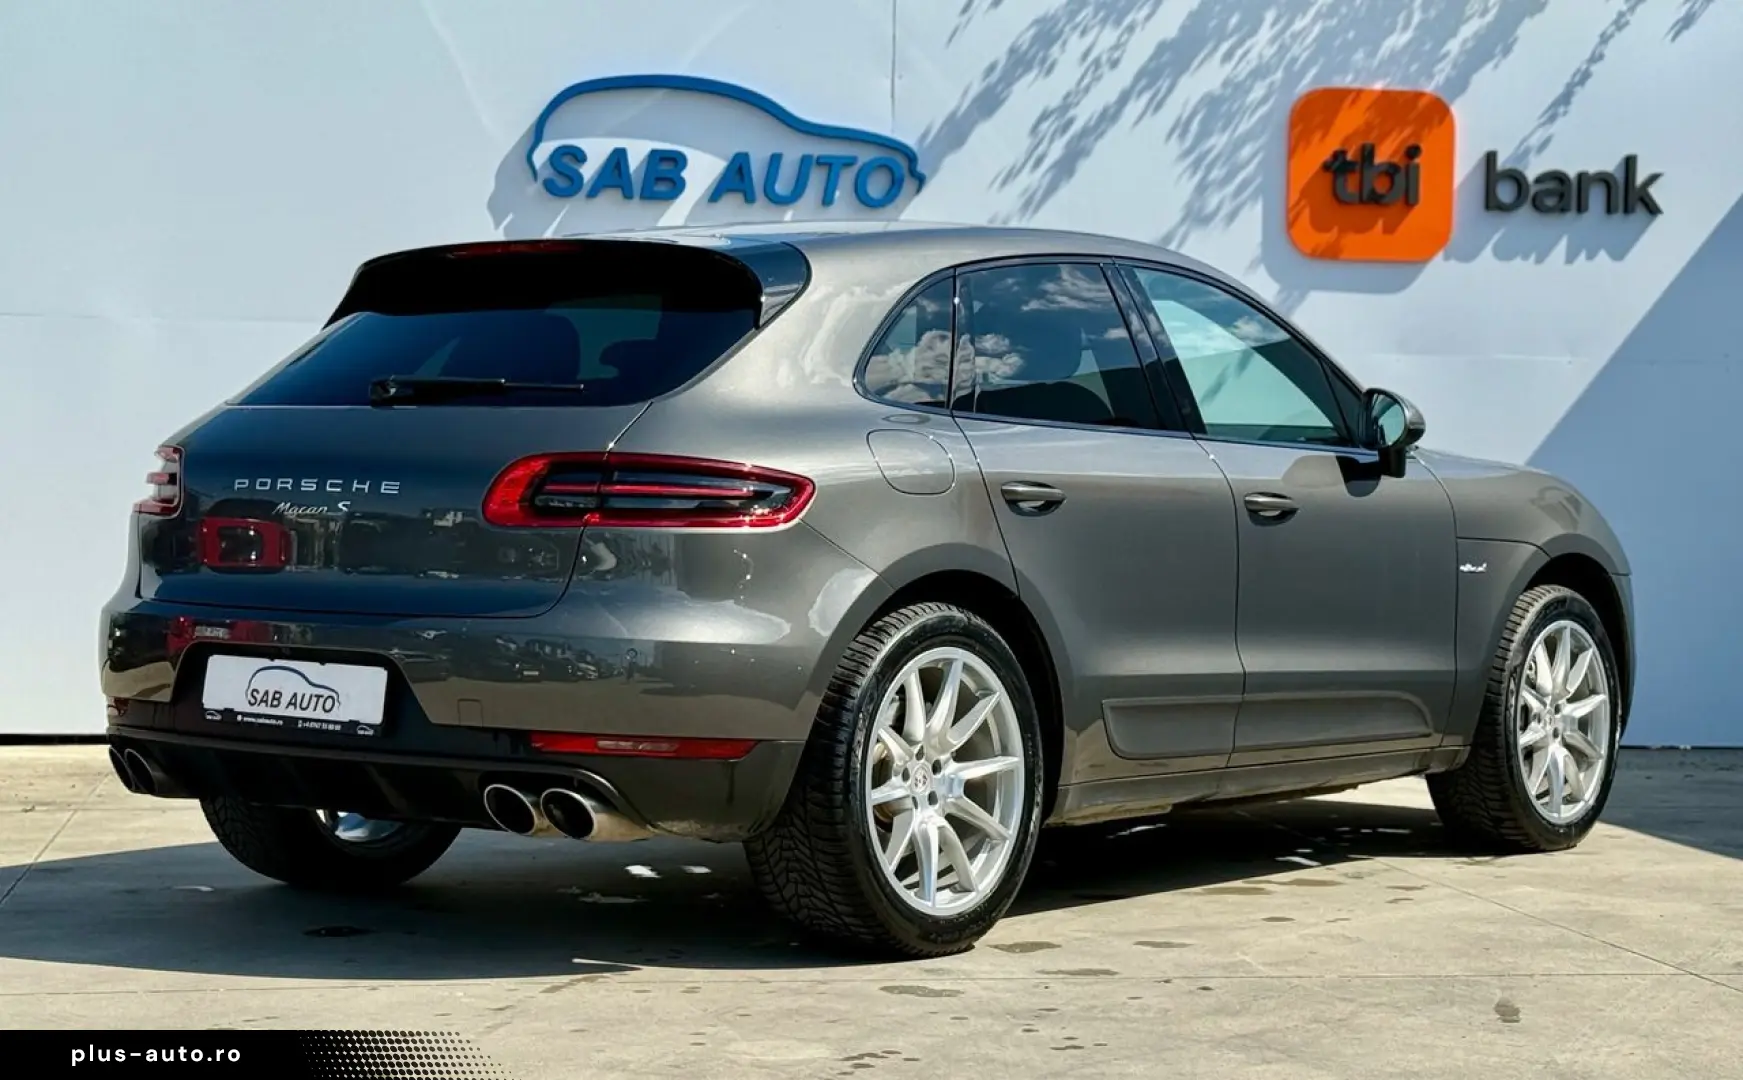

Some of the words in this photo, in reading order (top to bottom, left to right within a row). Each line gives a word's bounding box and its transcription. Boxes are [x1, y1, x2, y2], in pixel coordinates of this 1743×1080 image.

[542, 144, 688, 200] SAB
[708, 152, 905, 208] AUTO
[1322, 143, 1422, 206] tbi
[1483, 151, 1664, 217] bank
[234, 478, 401, 494] PORSCHE
[272, 501, 328, 518] Macan
[333, 500, 351, 514] S
[247, 688, 283, 709] SAB
[285, 692, 336, 713] AUTO
